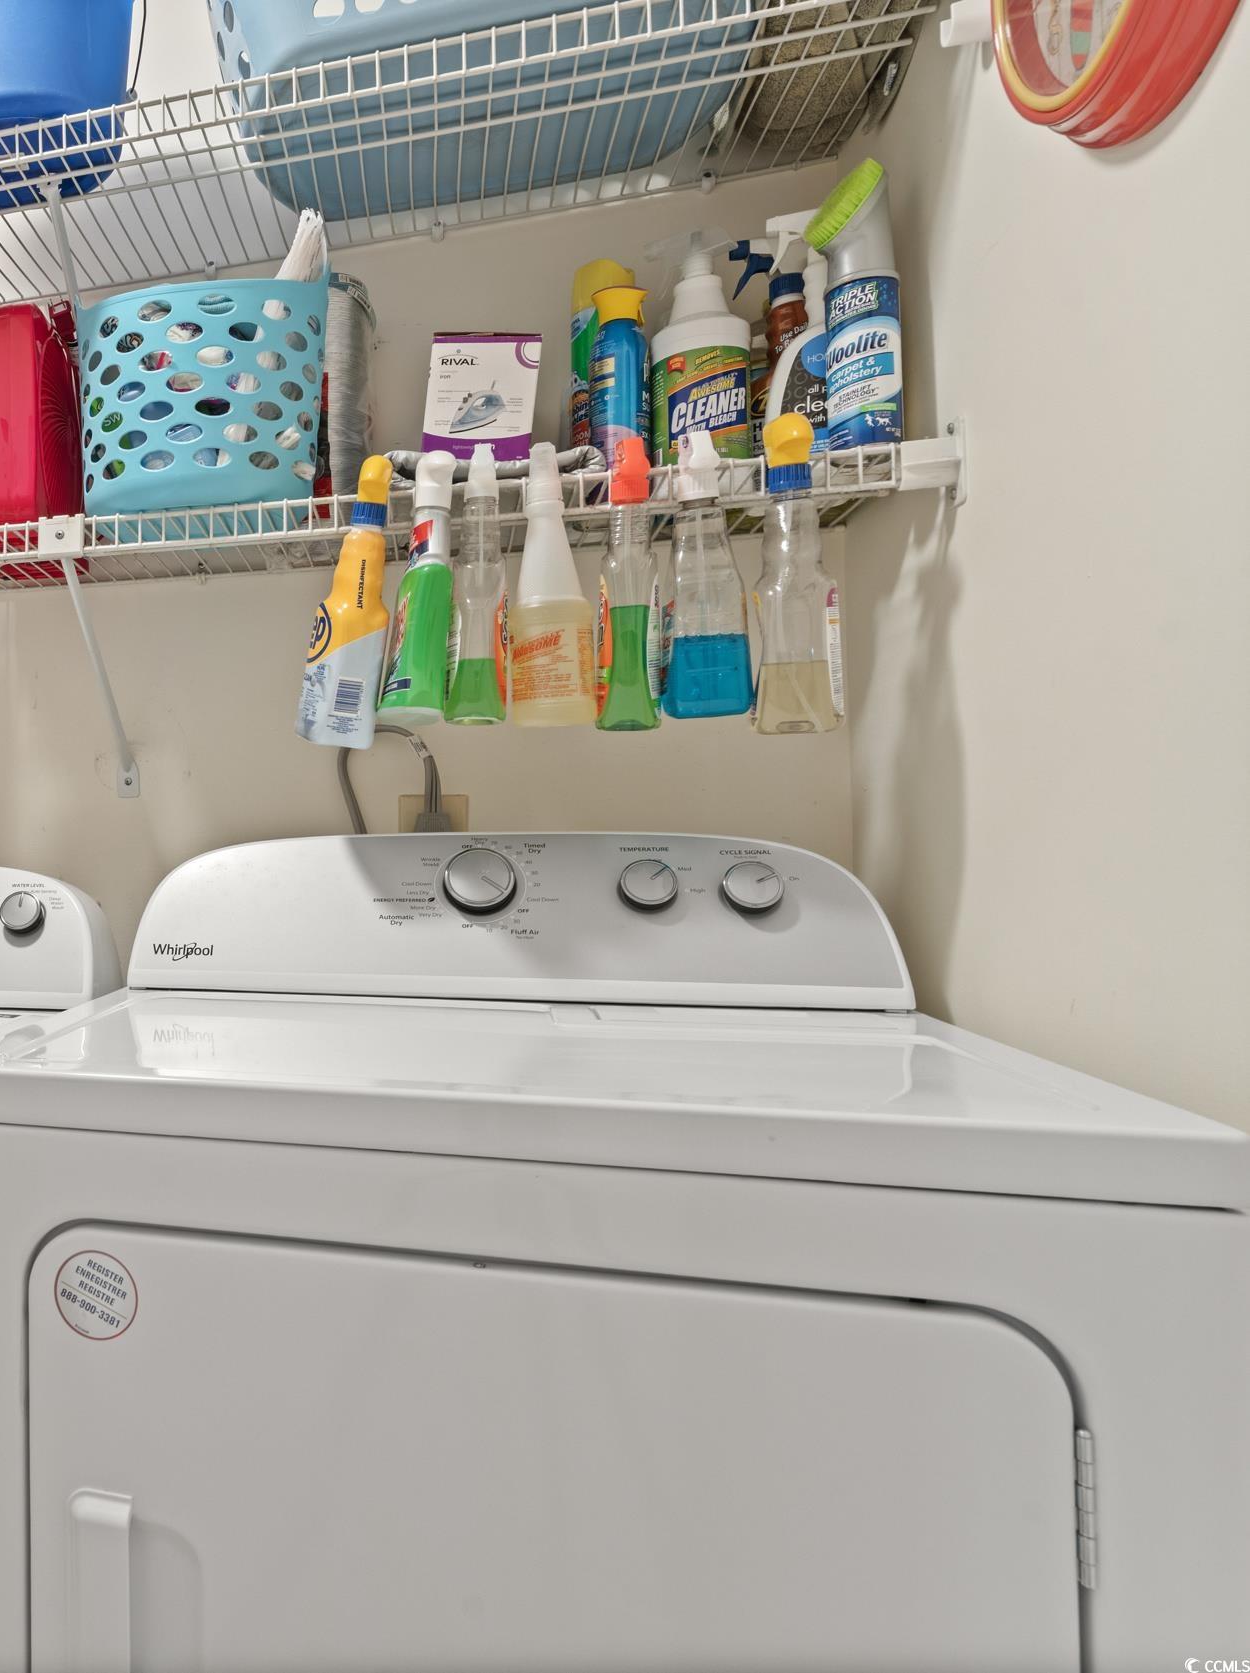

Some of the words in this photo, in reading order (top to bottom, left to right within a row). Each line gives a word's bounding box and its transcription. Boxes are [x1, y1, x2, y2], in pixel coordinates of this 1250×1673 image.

[830, 290, 877, 320] ACTION
[831, 282, 874, 309] TRIPLE
[775, 345, 784, 355] To
[780, 331, 793, 342] Use
[441, 358, 478, 366] RIVAL
[807, 354, 827, 364] HO
[826, 331, 888, 372] Woolite
[831, 359, 864, 383] carpet
[866, 356, 876, 367] &
[688, 378, 735, 402] AWESOME
[808, 384, 819, 394] all
[838, 384, 872, 402] STAINLIFT
[671, 387, 746, 434] CLEANER
[708, 412, 737, 428] BLEACH
[356, 559, 367, 610] DISINFECTANT
[152, 942, 214, 962] Whirlpool
[75, 1265, 128, 1300] ENREGISTRER
[86, 1258, 124, 1286] REGISTER
[78, 1279, 116, 1306] REGISTRE
[60, 1287, 121, 1328] 888-900-3381
